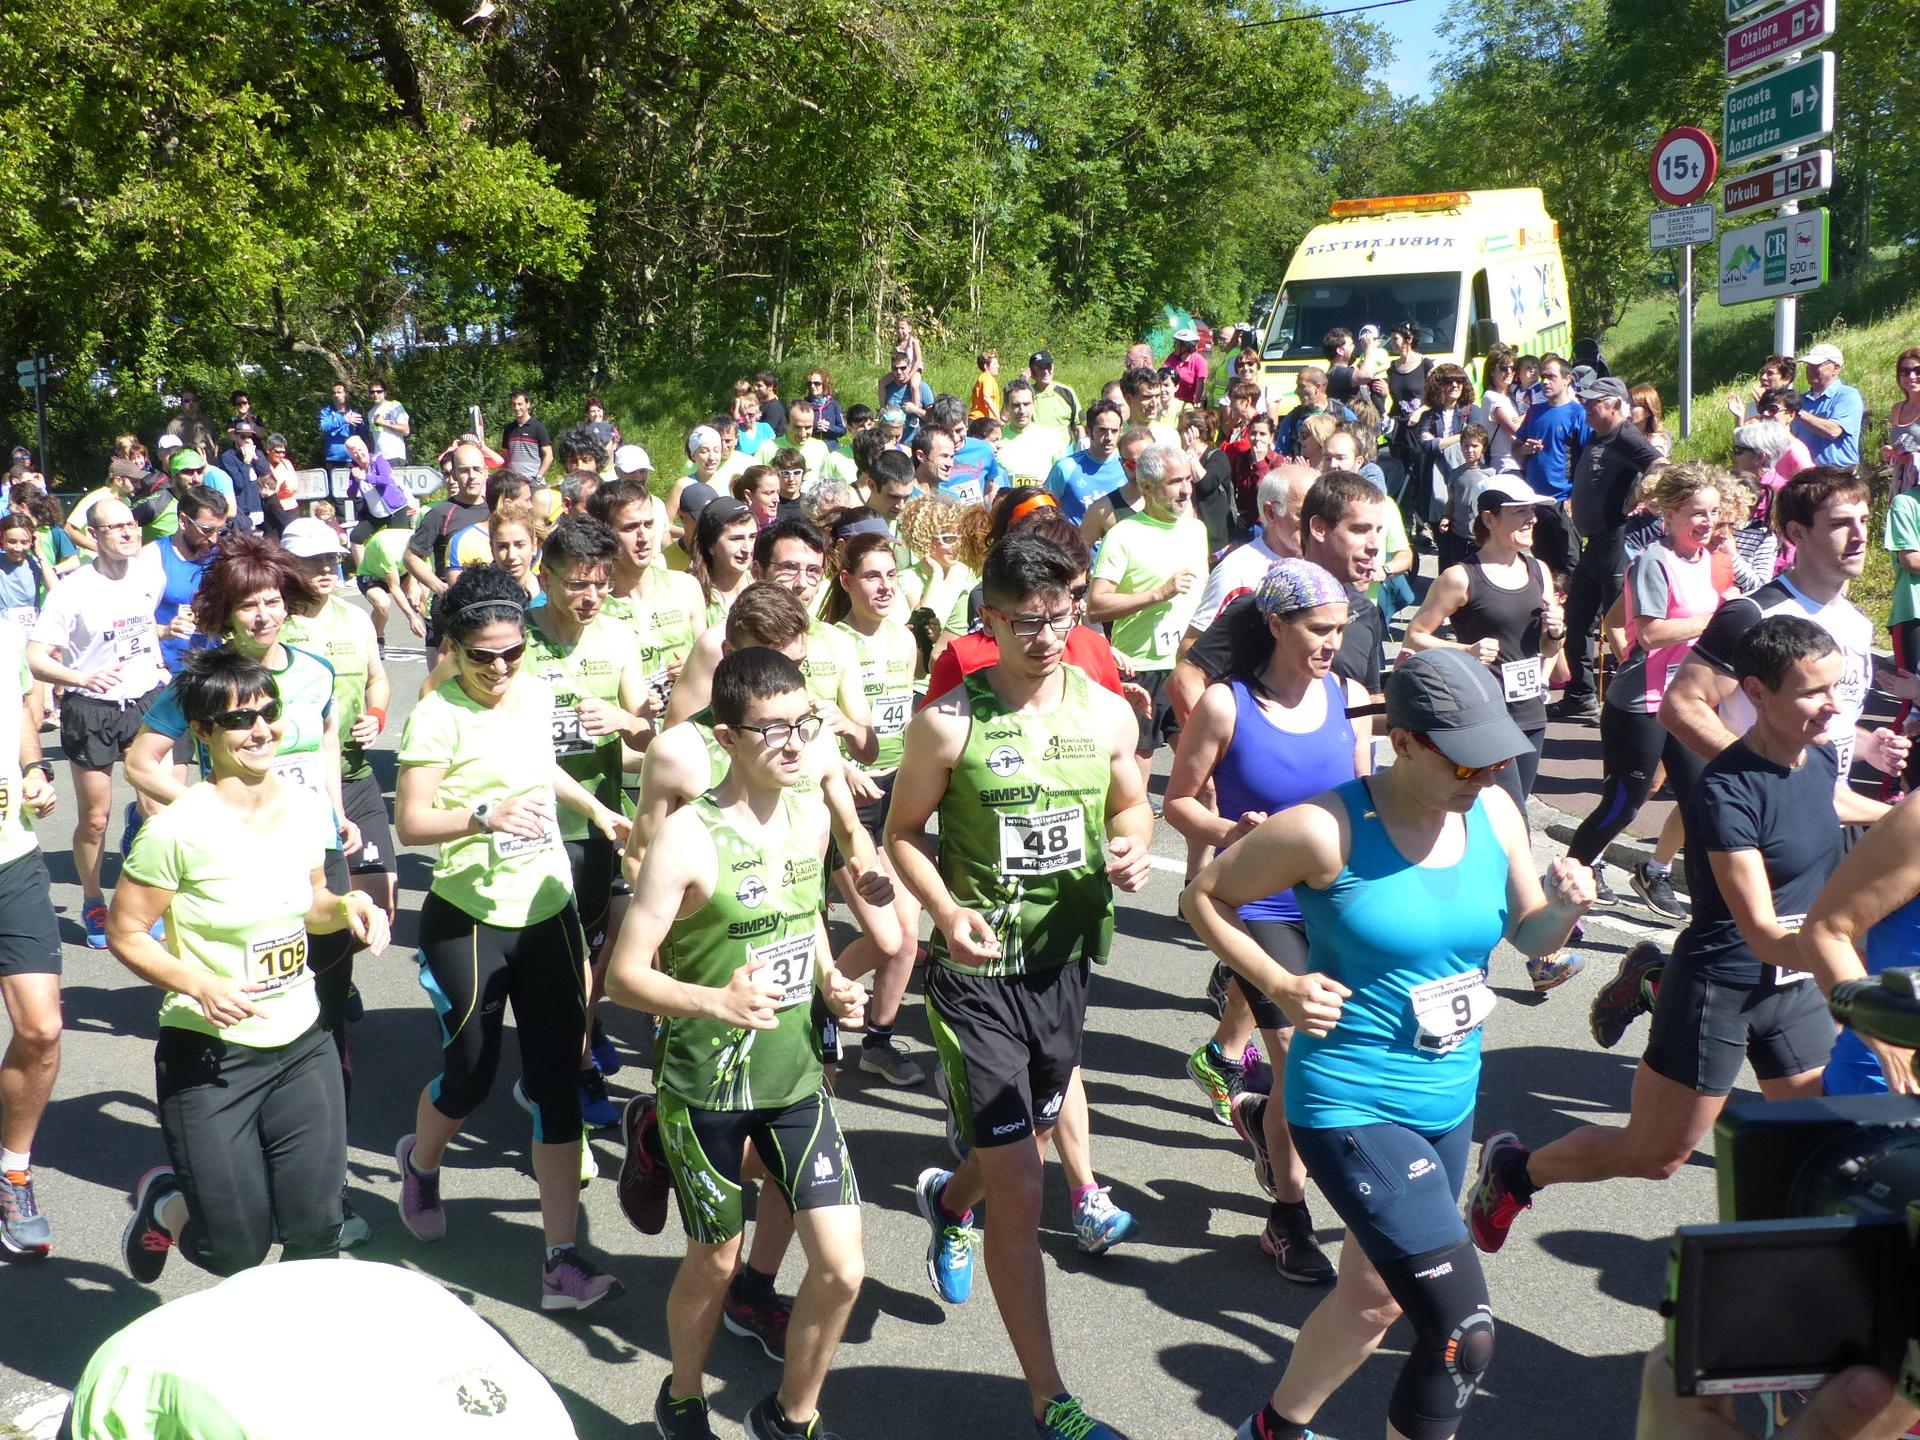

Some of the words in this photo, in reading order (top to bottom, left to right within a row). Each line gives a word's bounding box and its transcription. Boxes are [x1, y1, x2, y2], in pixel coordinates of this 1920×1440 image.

[1741, 22, 1778, 48] Otalora
[1773, 37, 1788, 49] torre
[1729, 88, 1771, 113] Goroeta
[1729, 107, 1776, 135] Areantza
[1728, 128, 1780, 155] Aozaratza
[1727, 183, 1760, 205] Urkulu
[1766, 233, 1786, 258] CR
[1790, 261, 1807, 275] 500
[960, 487, 975, 498] 41
[131, 637, 139, 650] 2
[1517, 669, 1535, 686] 99
[883, 705, 904, 723] 44
[552, 720, 580, 740] 31
[1061, 744, 1096, 753] SAIATU
[1024, 825, 1068, 855] 48
[259, 940, 306, 976] 109
[773, 951, 809, 986] 37
[1451, 994, 1471, 1027] 9
